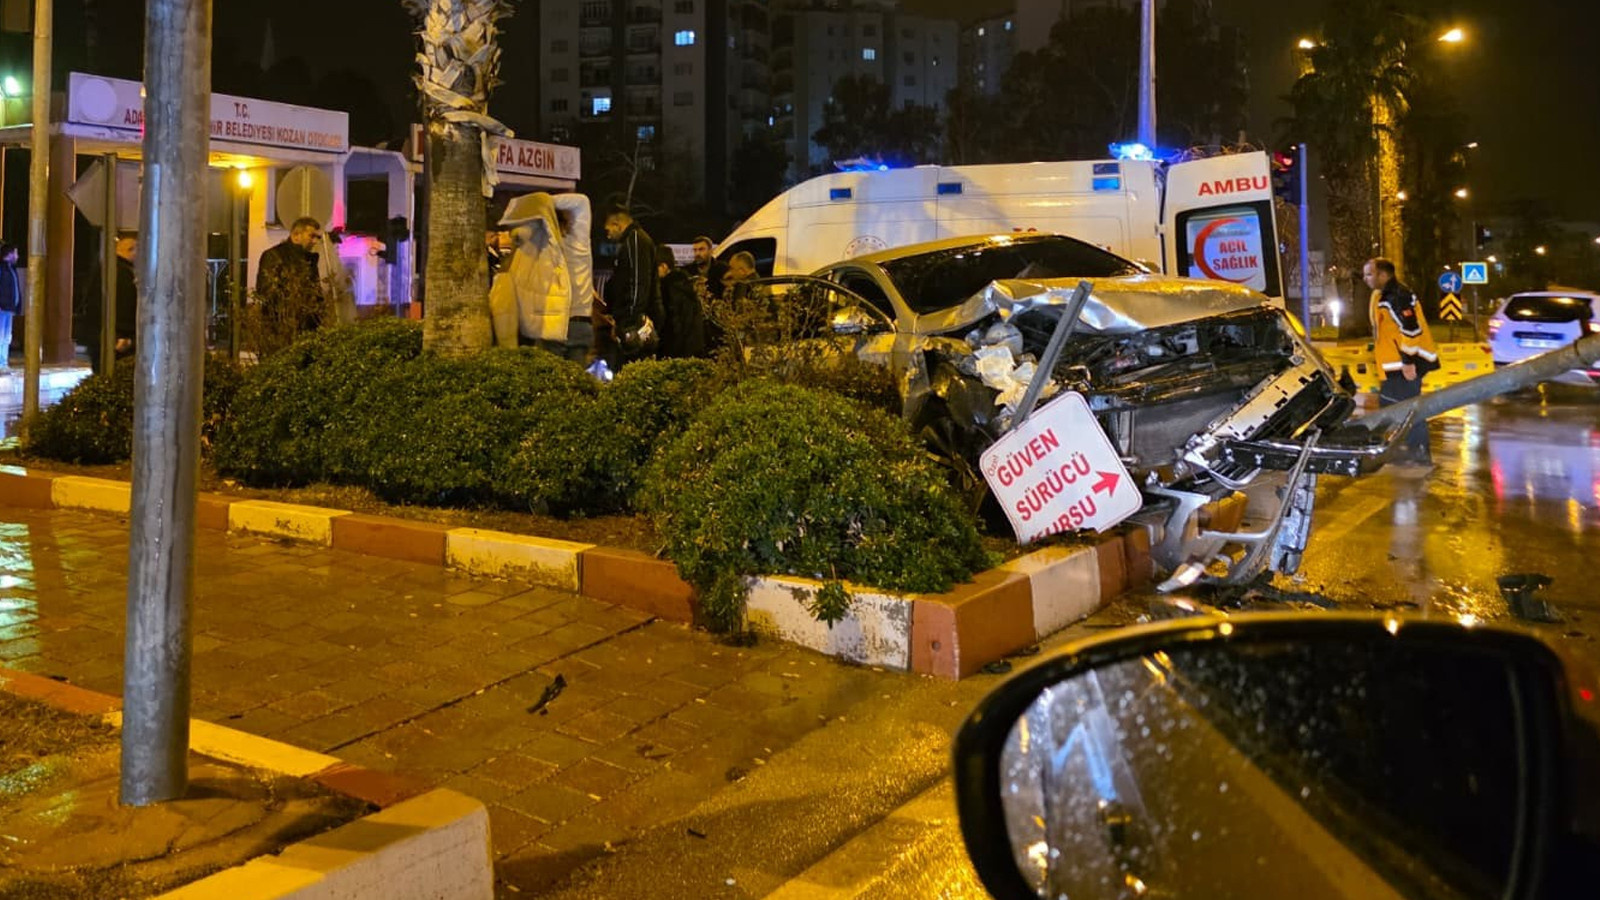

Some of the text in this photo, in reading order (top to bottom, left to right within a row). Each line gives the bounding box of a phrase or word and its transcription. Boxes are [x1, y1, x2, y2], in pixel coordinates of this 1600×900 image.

[233, 102, 250, 118] T.C.
[124, 108, 144, 125] ADA
[277, 126, 305, 144] KOZAN
[497, 143, 555, 171] FA AZGIN
[1198, 175, 1268, 196] AMBU
[1213, 255, 1258, 271] SAĞLIK
[997, 428, 1060, 487] GÜVEN
[1016, 451, 1091, 522] SÜRÜCÜ
